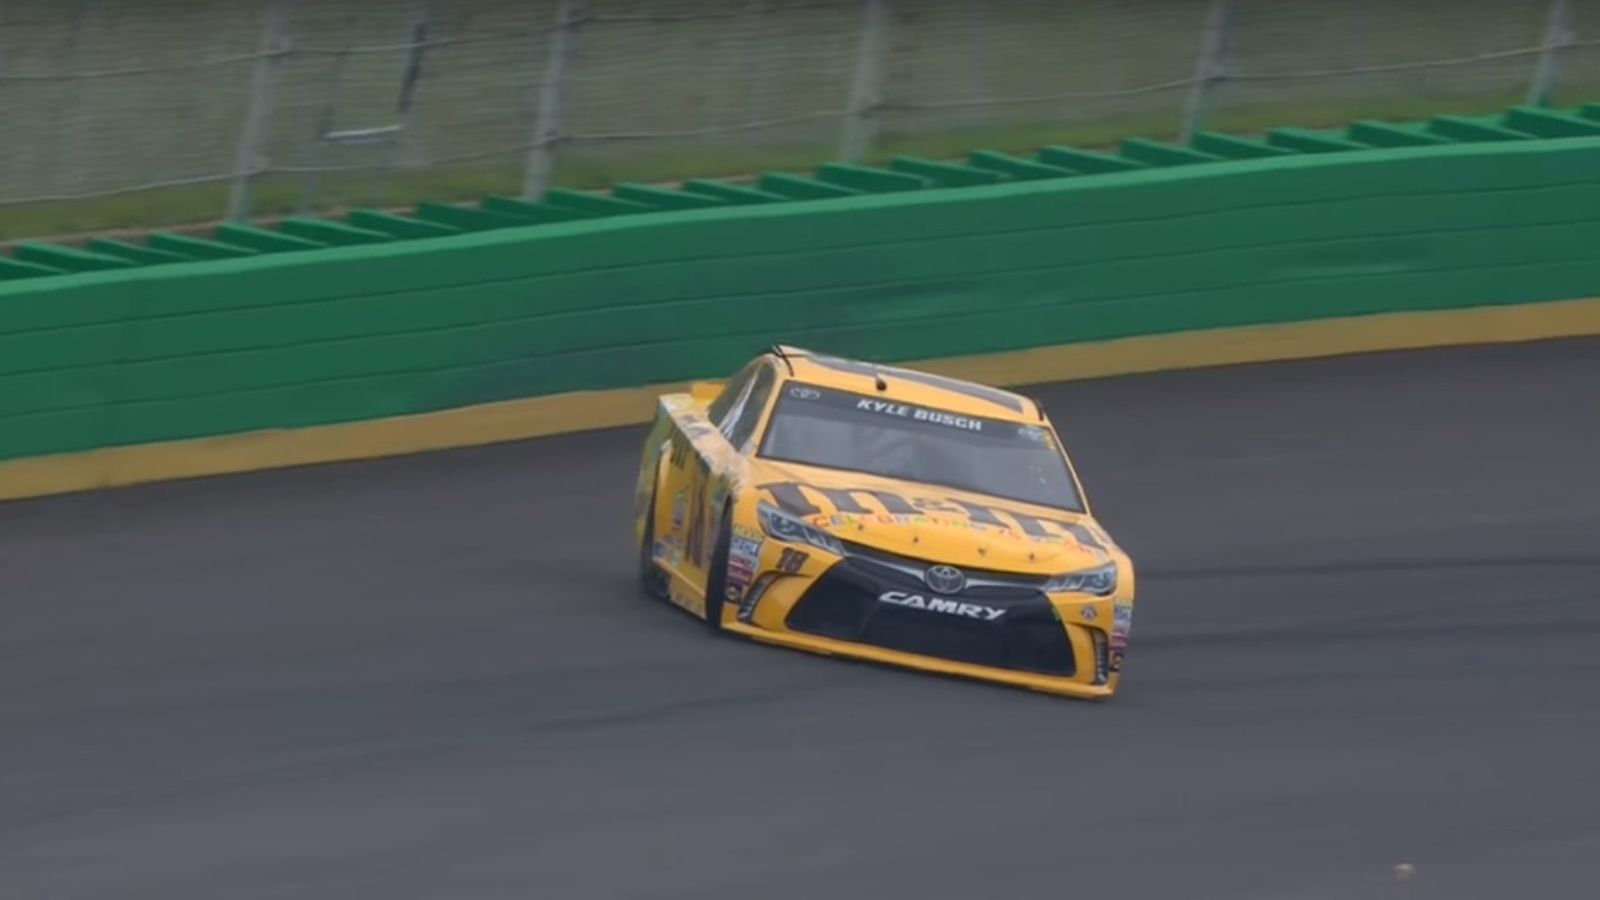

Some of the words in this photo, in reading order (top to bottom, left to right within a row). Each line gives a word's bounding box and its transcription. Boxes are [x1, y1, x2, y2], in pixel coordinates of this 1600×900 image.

[857, 399, 908, 417] KYLE
[914, 409, 982, 432] BUSCH
[776, 547, 810, 576] 18
[878, 591, 1006, 620] CAMRY
